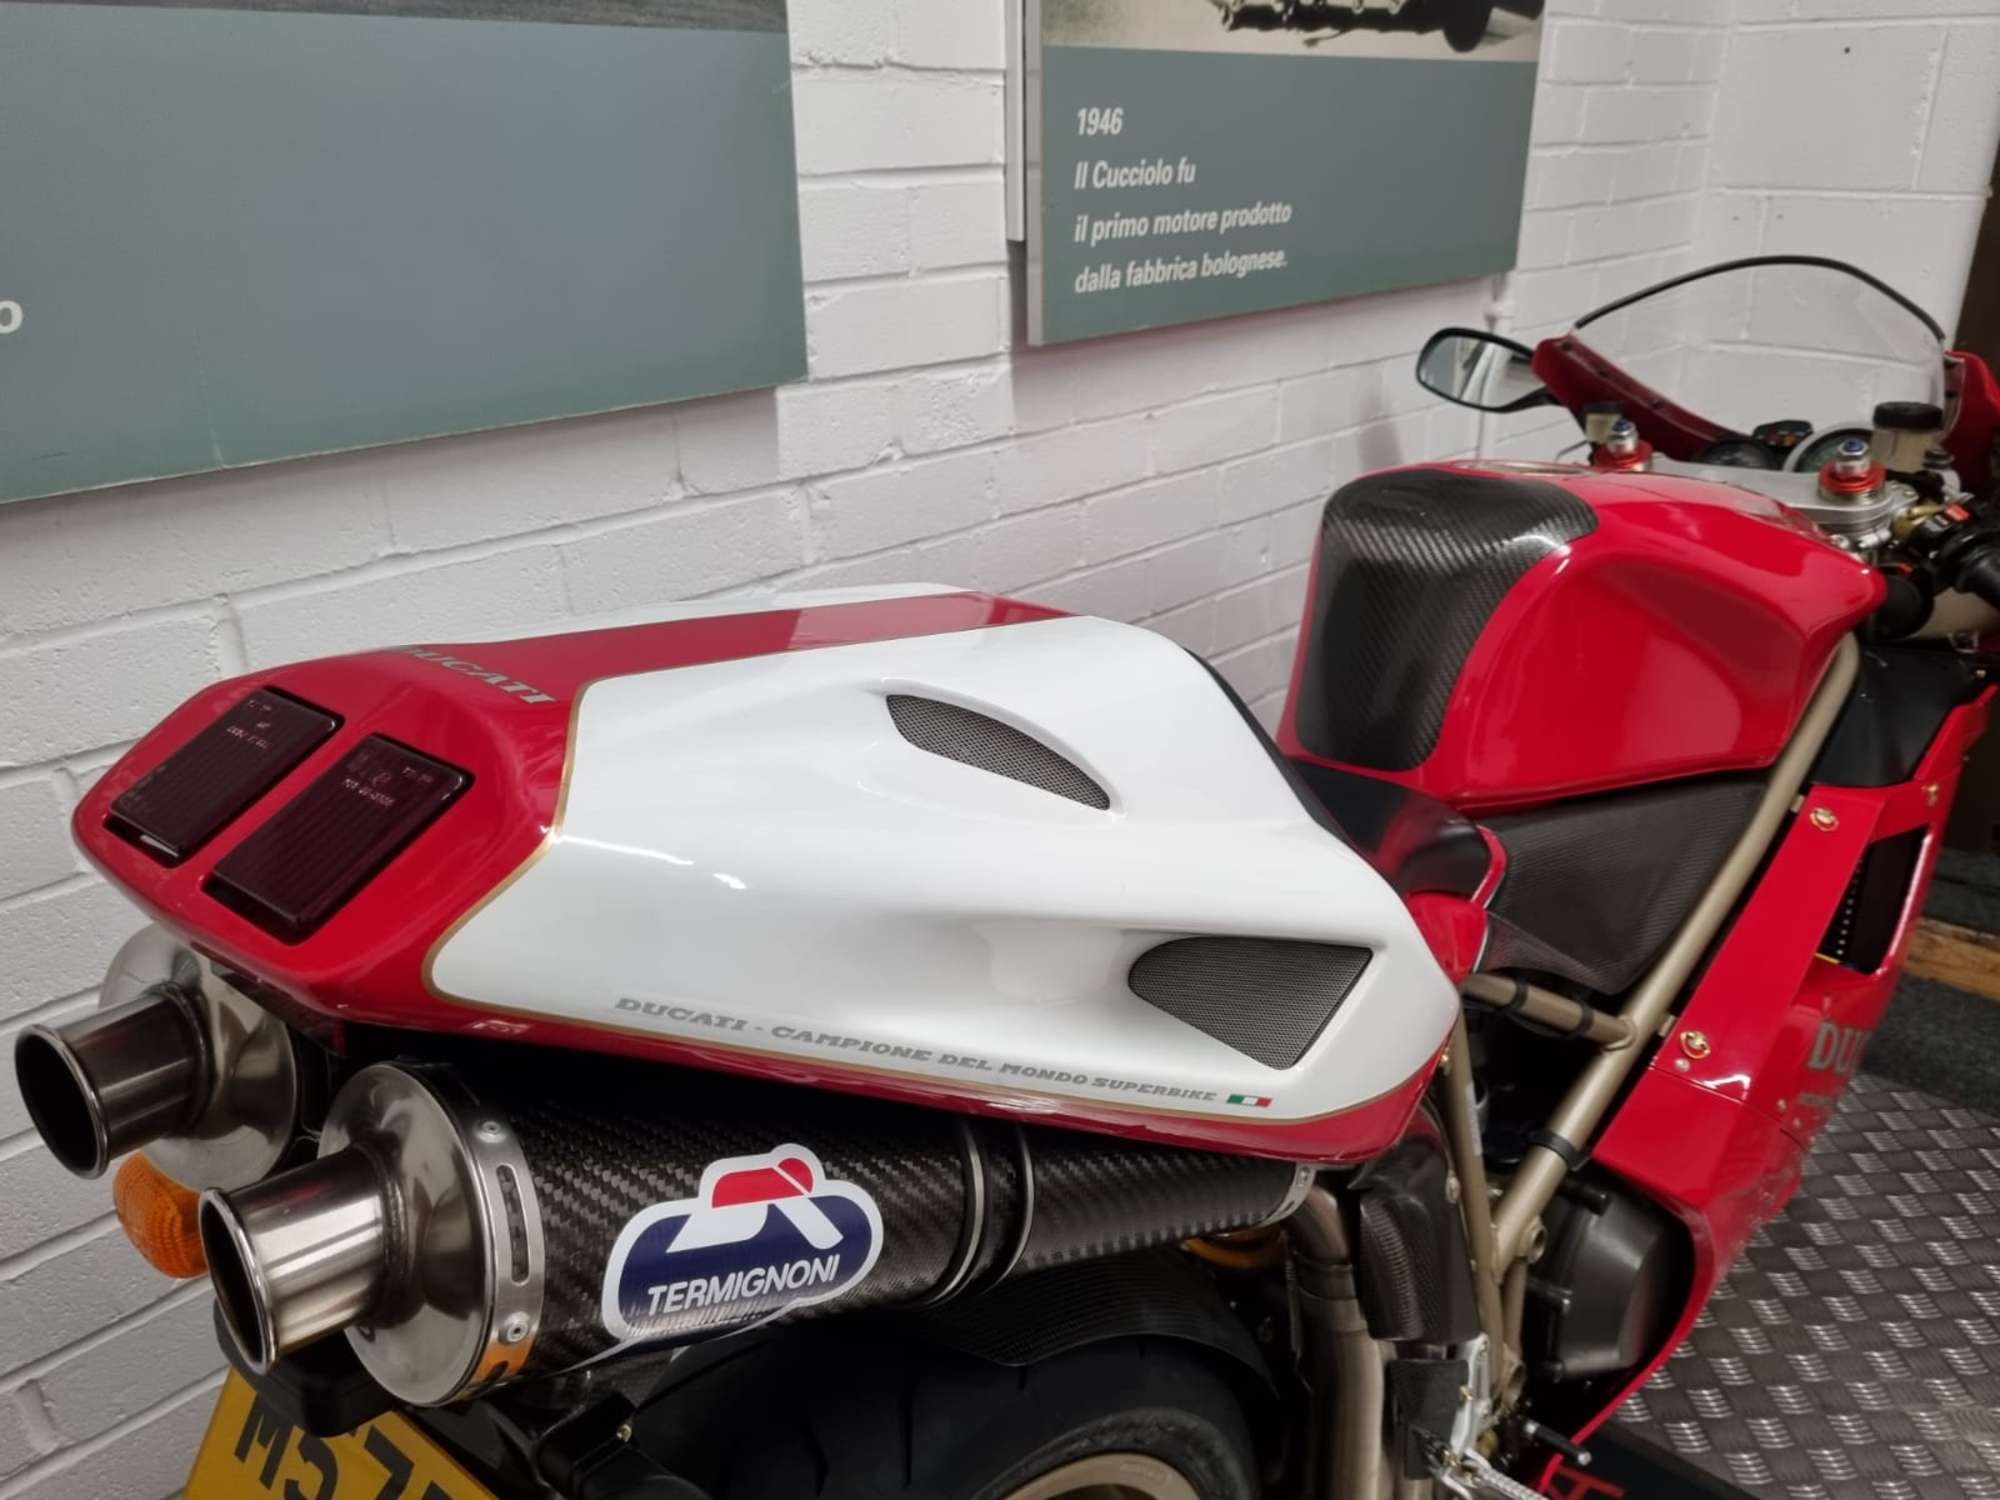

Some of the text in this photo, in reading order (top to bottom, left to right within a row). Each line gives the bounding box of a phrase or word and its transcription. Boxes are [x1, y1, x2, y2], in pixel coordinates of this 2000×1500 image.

[1077, 107, 1124, 136] 1946
[1074, 156, 1196, 190] Il Cucciolo fu
[1074, 201, 1292, 247] il primo motore prodotto
[1075, 249, 1287, 293] dalla fabbrica bolognese.
[615, 997, 748, 1032] DUCATI
[772, 1025, 932, 1062] CAMPIONE
[938, 1051, 993, 1071] DEL
[1000, 1062, 1088, 1086] MONDO
[1092, 1076, 1218, 1103] SUPERBIKE
[1808, 1022, 1871, 1073] DU
[647, 1253, 842, 1317] TERMIGNONI
